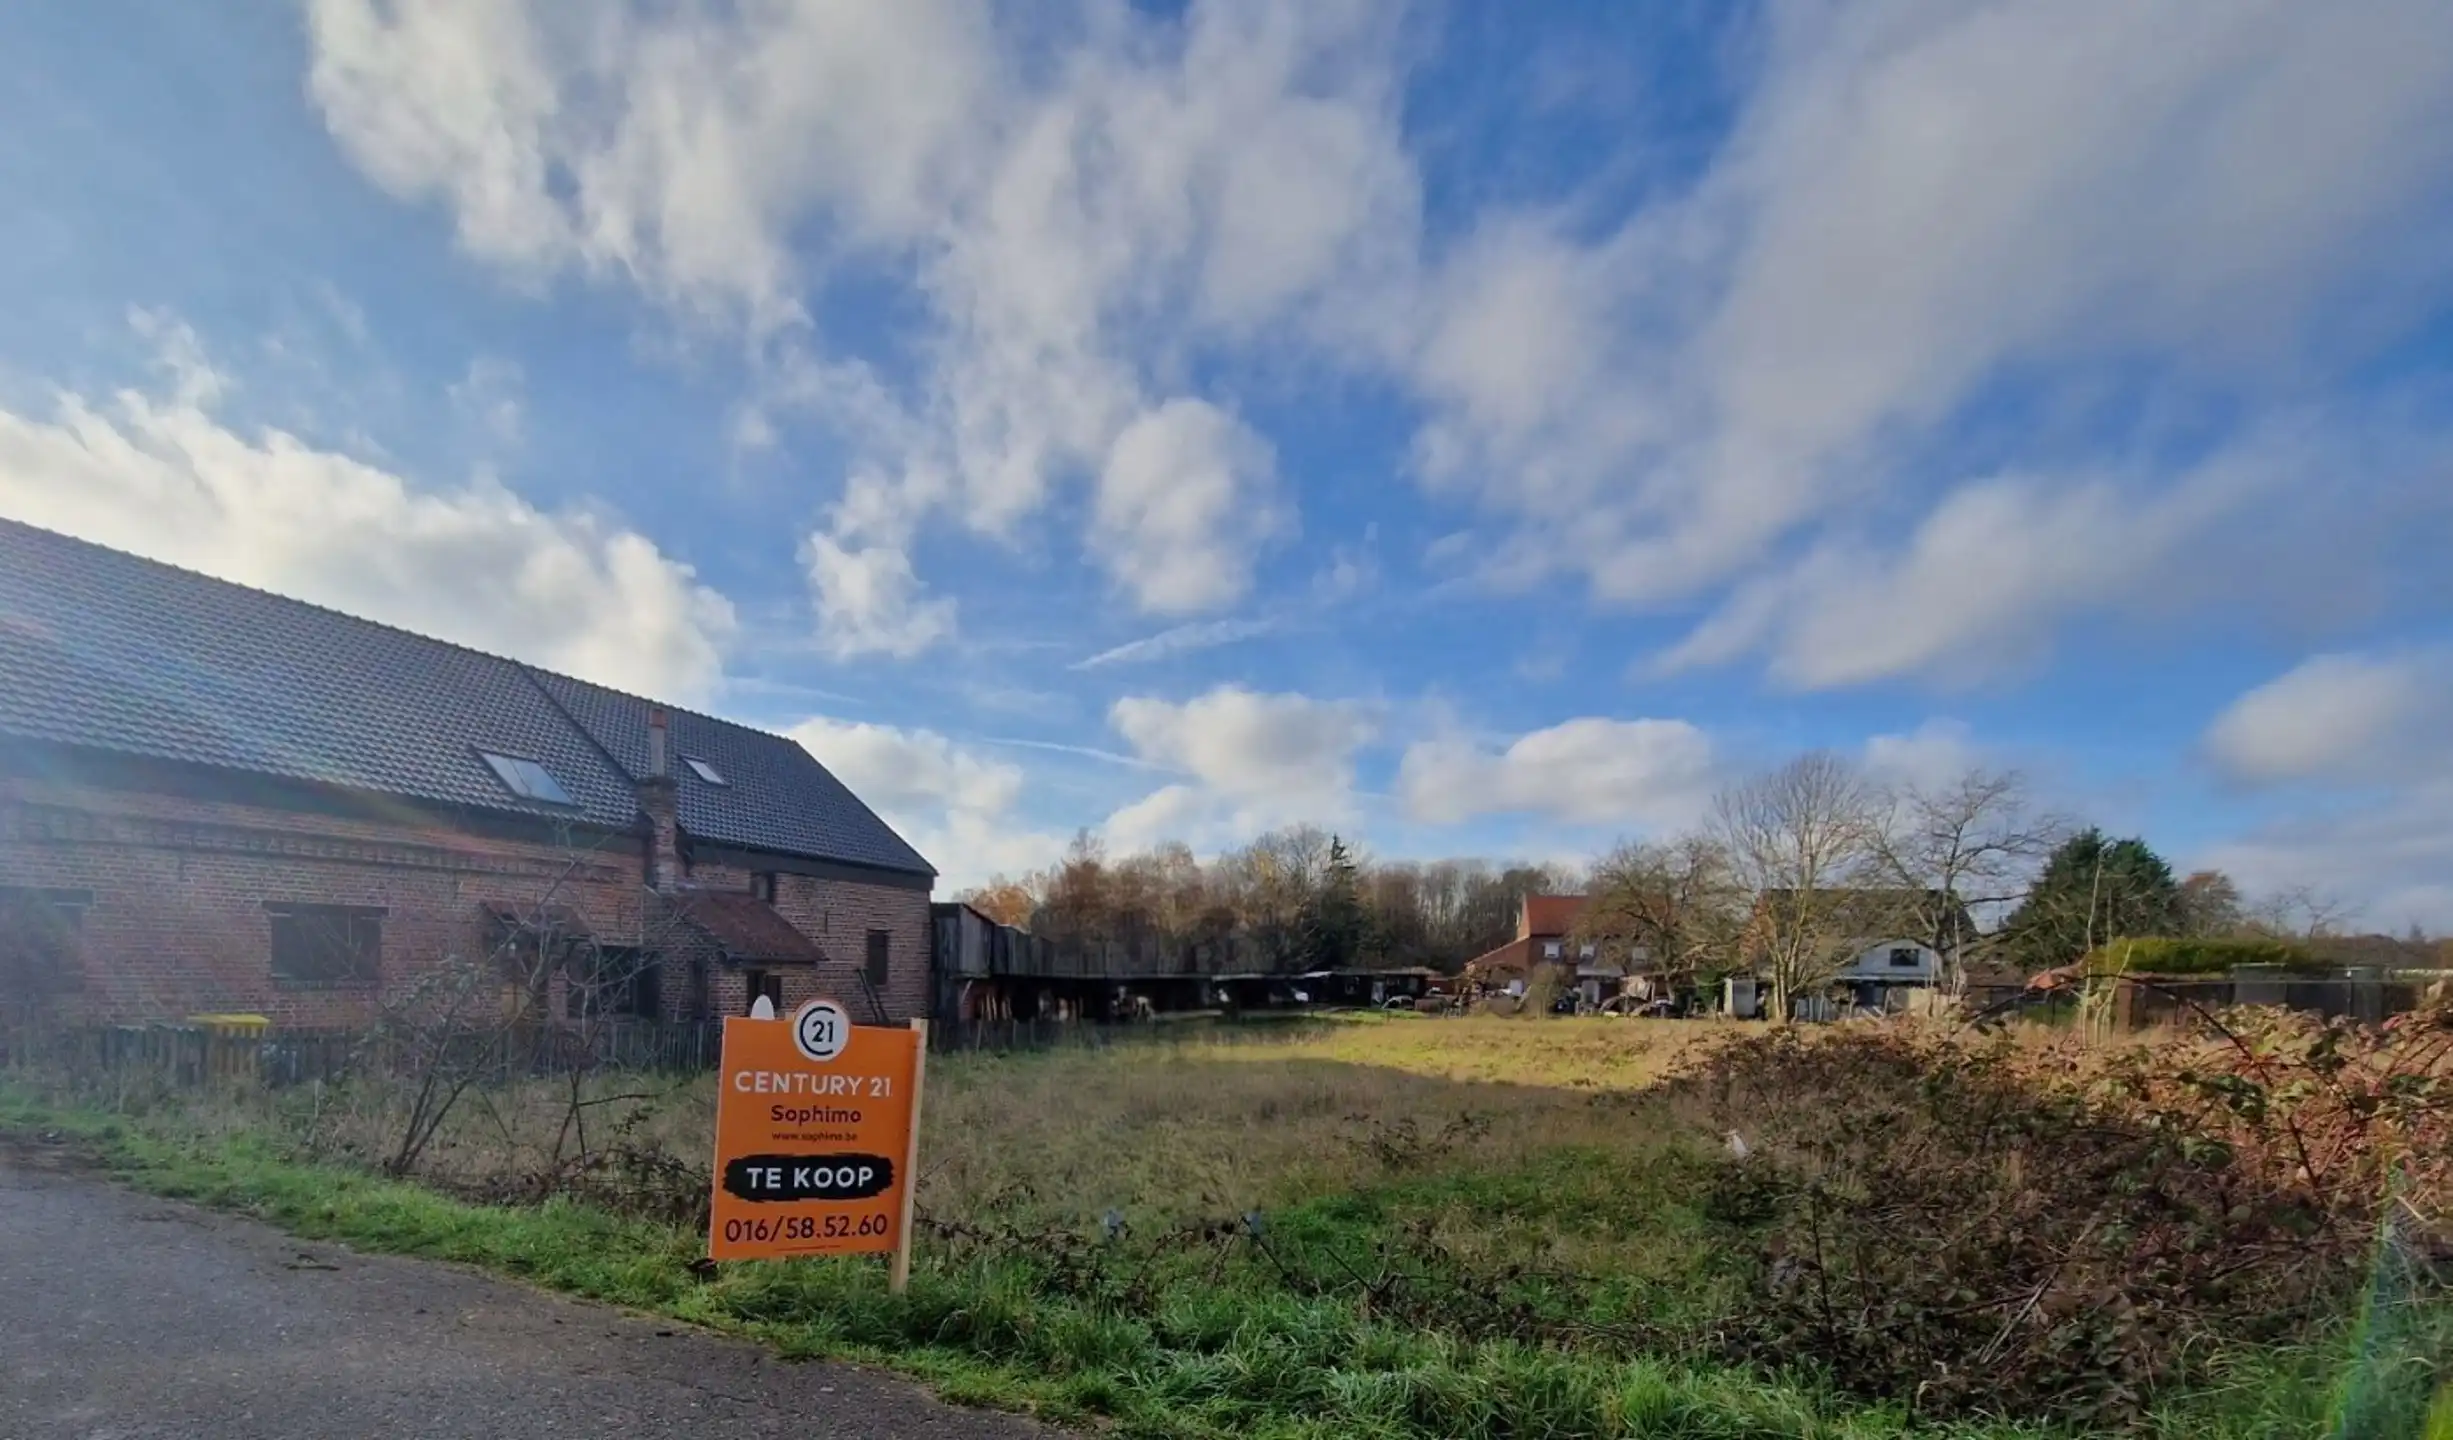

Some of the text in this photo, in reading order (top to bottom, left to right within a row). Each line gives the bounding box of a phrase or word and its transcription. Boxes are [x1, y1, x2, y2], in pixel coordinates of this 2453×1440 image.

[735, 1071, 892, 1097] CENTURY 21
[771, 1104, 862, 1126] Sophimo
[746, 1166, 874, 1189] TE KOOP
[725, 1213, 888, 1243] 016/58.52.60
